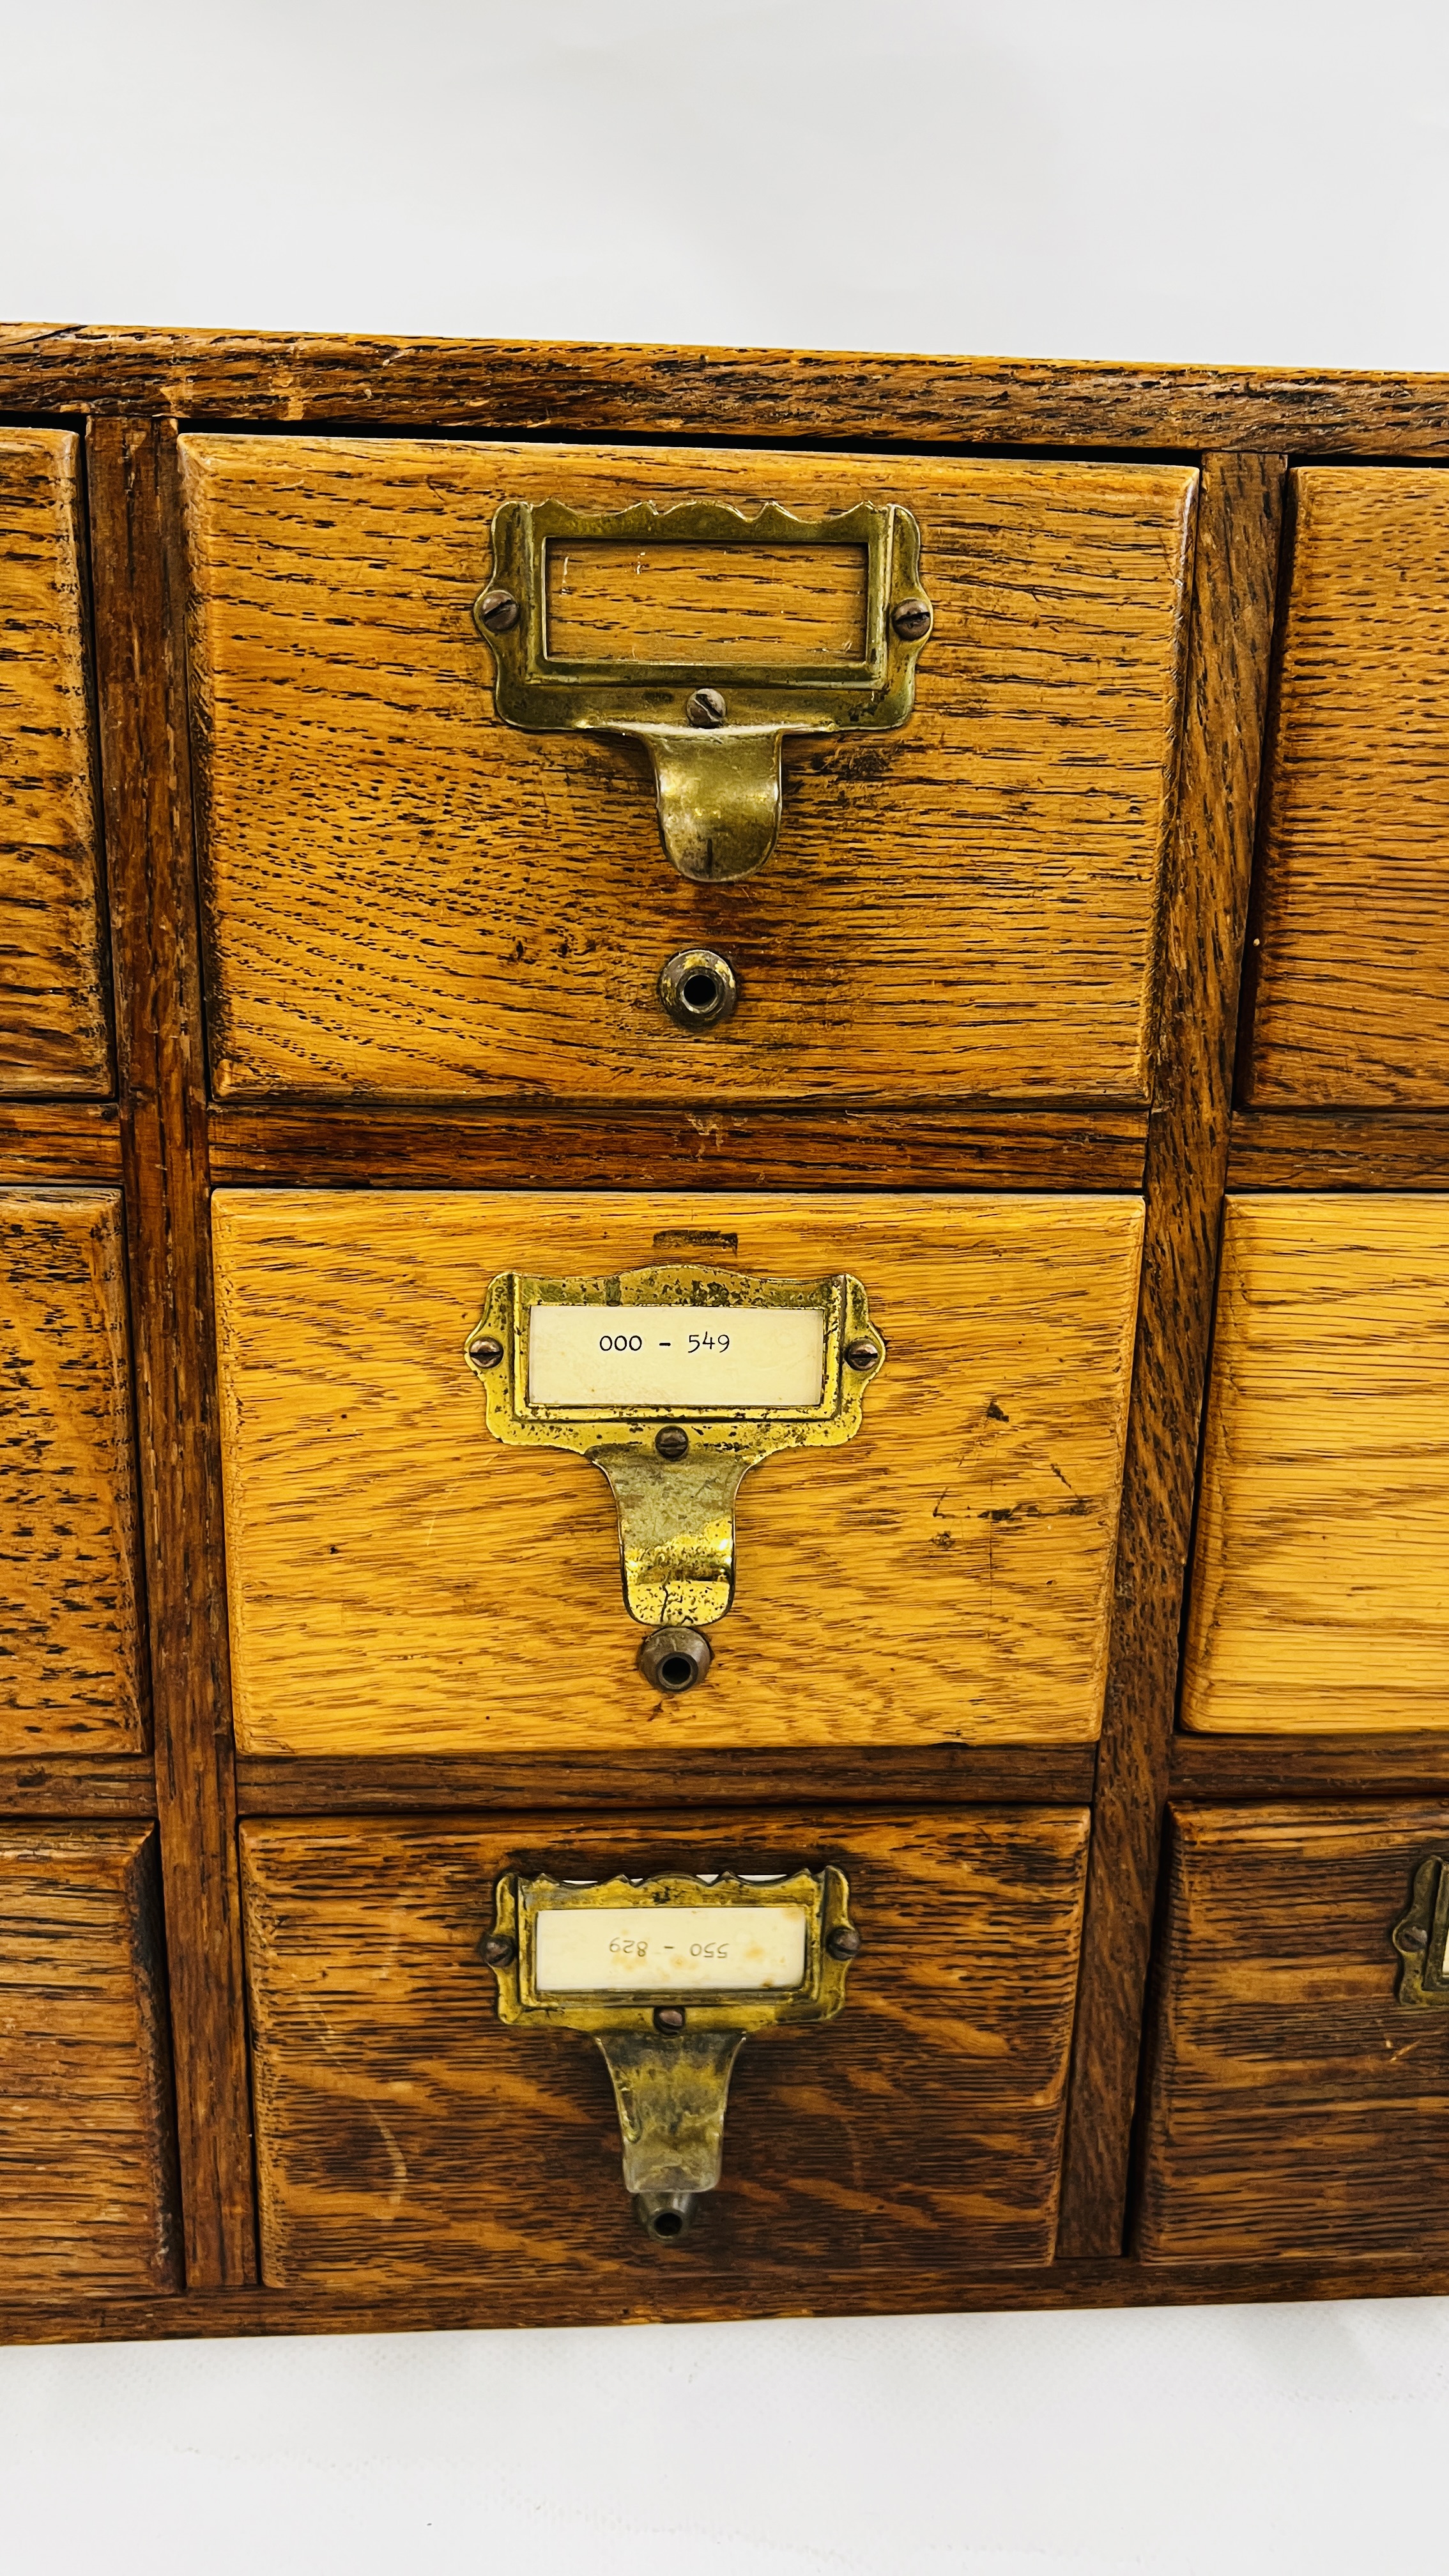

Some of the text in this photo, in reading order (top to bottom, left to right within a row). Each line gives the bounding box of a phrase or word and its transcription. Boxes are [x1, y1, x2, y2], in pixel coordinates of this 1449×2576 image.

[599, 1335, 643, 1352] 000
[687, 1331, 730, 1353] 549
[608, 1936, 648, 1958] 829
[690, 1943, 729, 1959] 550
